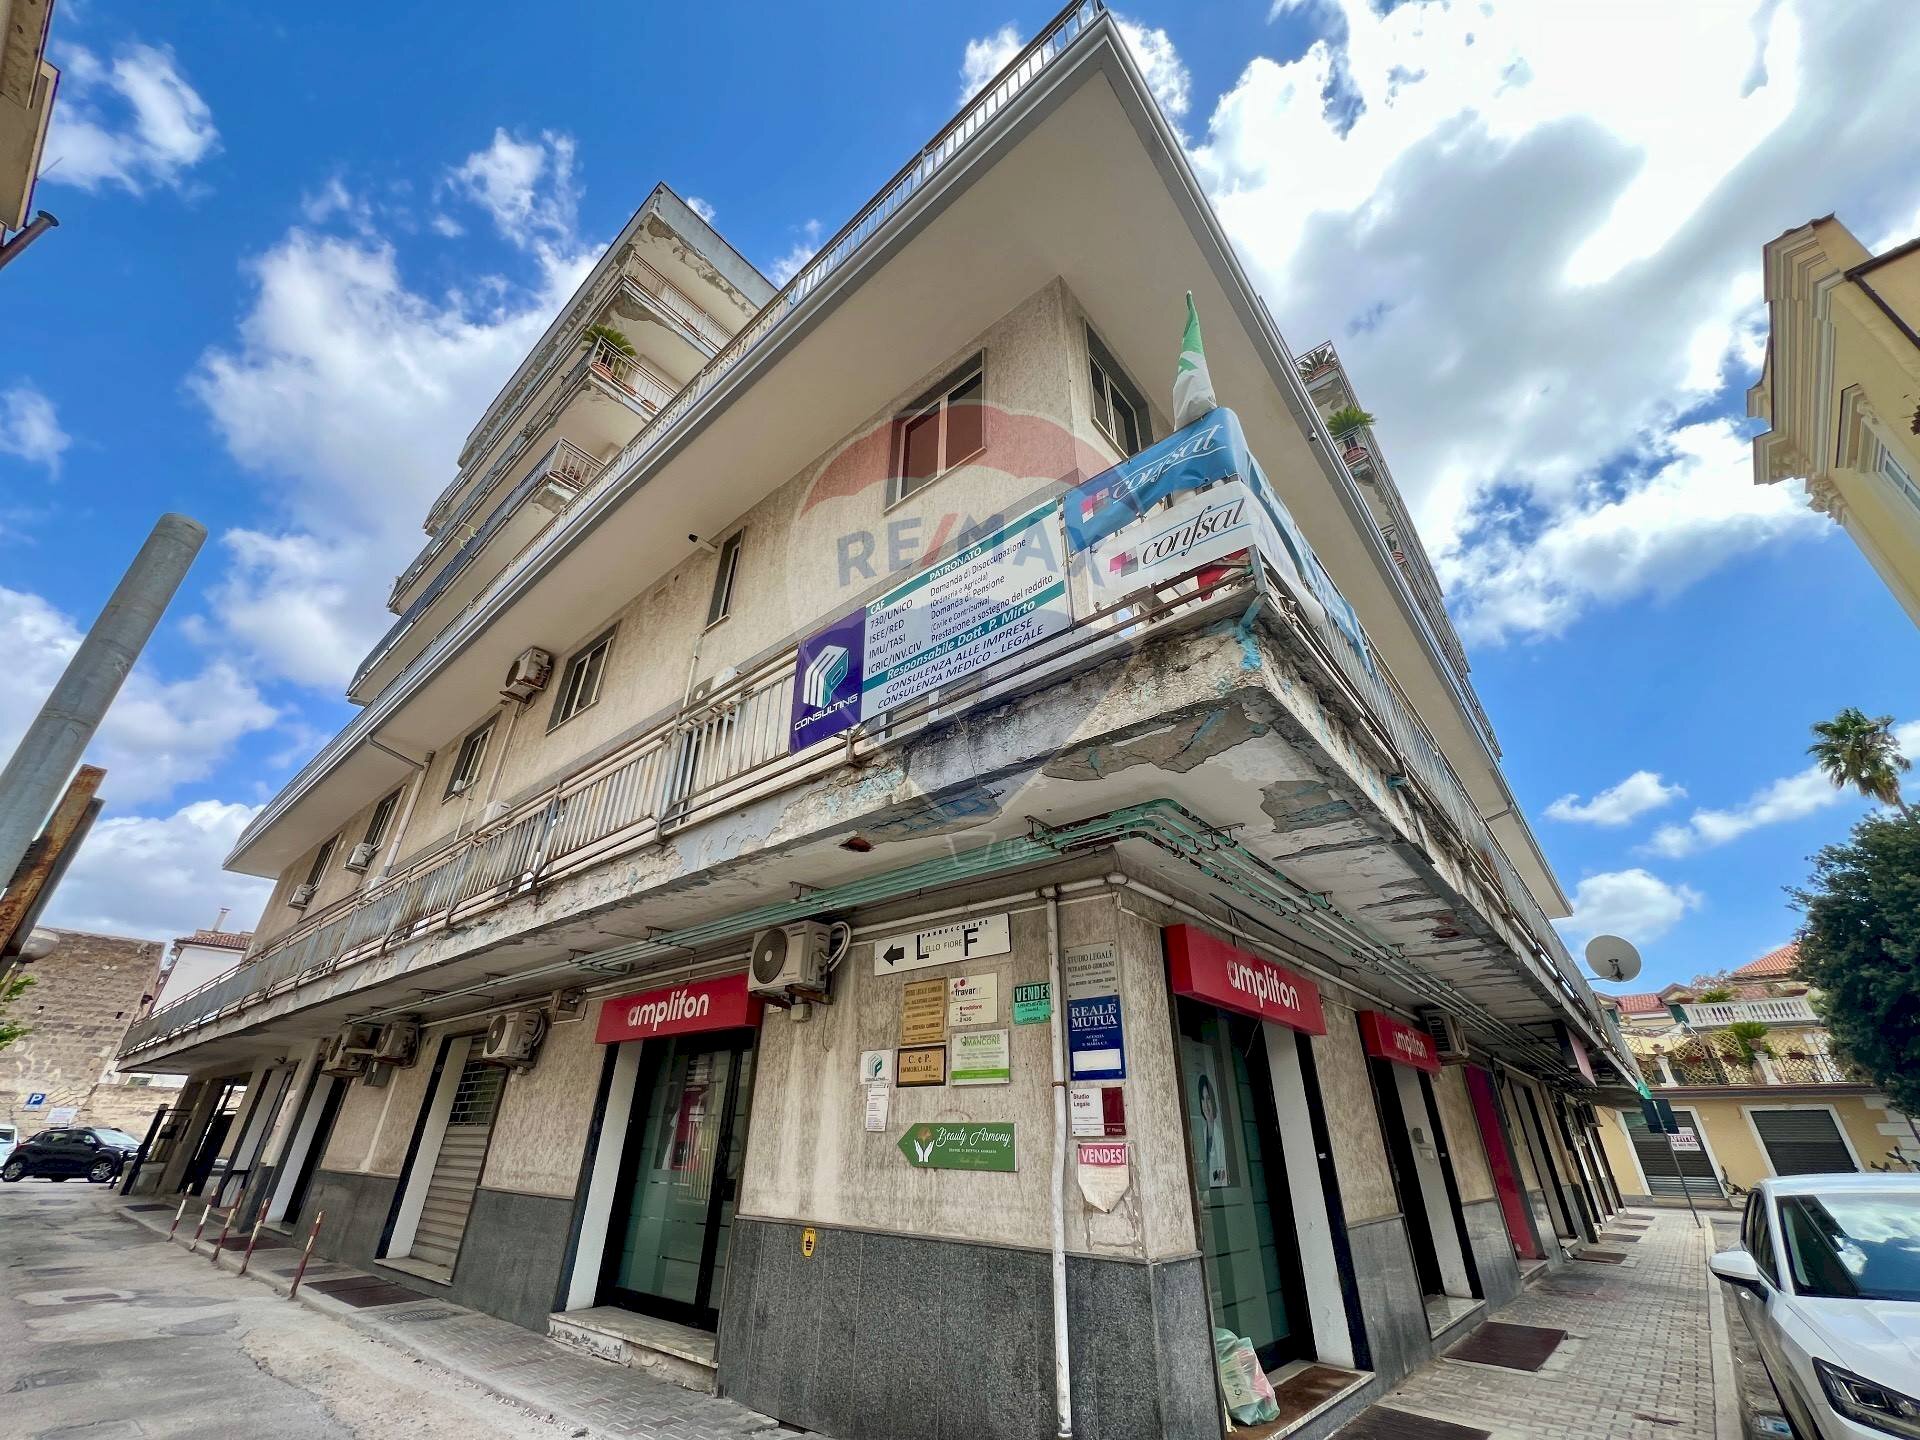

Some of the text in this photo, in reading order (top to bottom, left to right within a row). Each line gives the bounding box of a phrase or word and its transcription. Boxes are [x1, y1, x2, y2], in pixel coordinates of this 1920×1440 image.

[1113, 424, 1224, 500] confsal
[1141, 497, 1245, 565] confsal
[929, 547, 982, 582] PATRONATO
[930, 539, 1027, 597] Domanda di Disoccupazione
[870, 600, 885, 615] CAF
[870, 599, 913, 629] 730/UNICO
[931, 575, 1005, 620] Domanda di Pensione
[931, 620, 973, 643] Prestazione
[977, 599, 1010, 621] sostegno
[1011, 592, 1023, 604] del
[1025, 575, 1053, 597] reddito
[869, 619, 905, 645] ISEE/RED
[869, 633, 906, 659] IMU/TASI
[887, 600, 1036, 681] Responsabile Dott. P. Mirto
[868, 640, 923, 675] ICRIC/INV.CIV
[877, 673, 943, 709] CONSULENZA
[946, 652, 991, 678] MEDICO
[1001, 624, 1044, 653] LEGALE
[886, 617, 1033, 694] CONSULENZA ALLE IMPRESE
[794, 693, 858, 732] CONSULTING
[917, 927, 979, 960] L F
[922, 938, 963, 953] LELLO FIORE
[1226, 959, 1300, 1012] amplifon
[628, 987, 710, 1031] amplifon
[1071, 1003, 1117, 1018] REALE
[1071, 1014, 1117, 1028] MUTUA
[30, 1094, 42, 1104] P
[1073, 1101, 1090, 1109] Legale
[935, 1126, 1011, 1148] Beauty Armony
[1081, 1148, 1125, 1164] VENDESI
